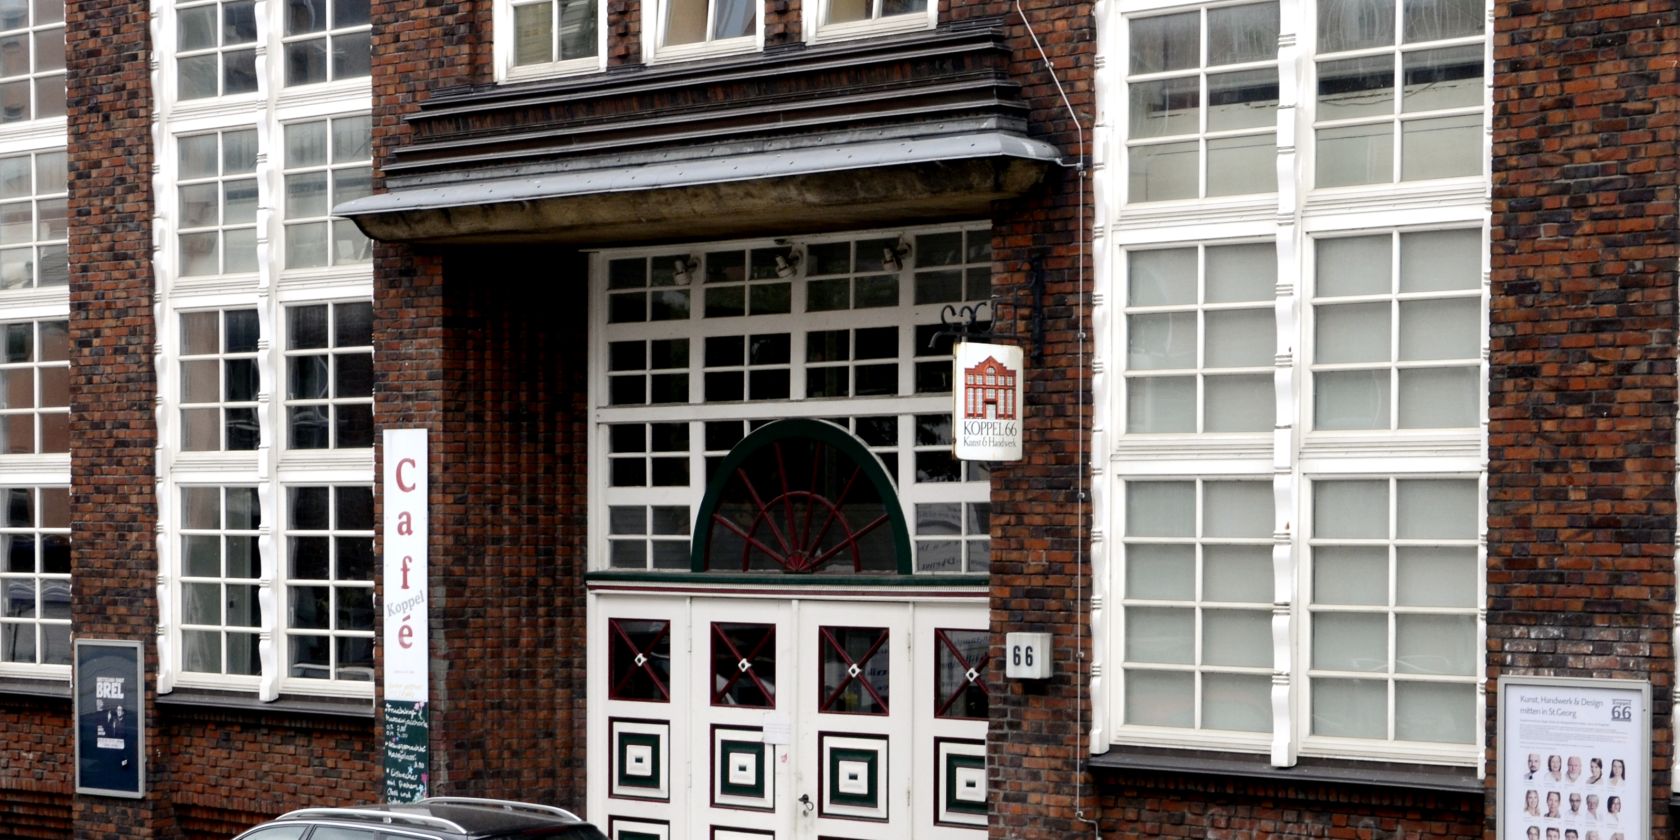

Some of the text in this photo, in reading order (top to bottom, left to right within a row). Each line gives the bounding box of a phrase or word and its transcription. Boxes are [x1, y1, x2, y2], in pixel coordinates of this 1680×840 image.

[964, 421, 1017, 437] KOPPEL 66
[964, 437, 981, 447] Kunst
[989, 437, 1016, 447] Handwerk
[395, 457, 417, 649] Café
[386, 590, 425, 618] Koppel
[1013, 645, 1033, 667] 66
[96, 682, 124, 699] BREL
[1520, 695, 1539, 705] Kunst,
[1541, 695, 1573, 705] Handwerk
[1581, 698, 1604, 709] Design
[1612, 705, 1632, 720] 66
